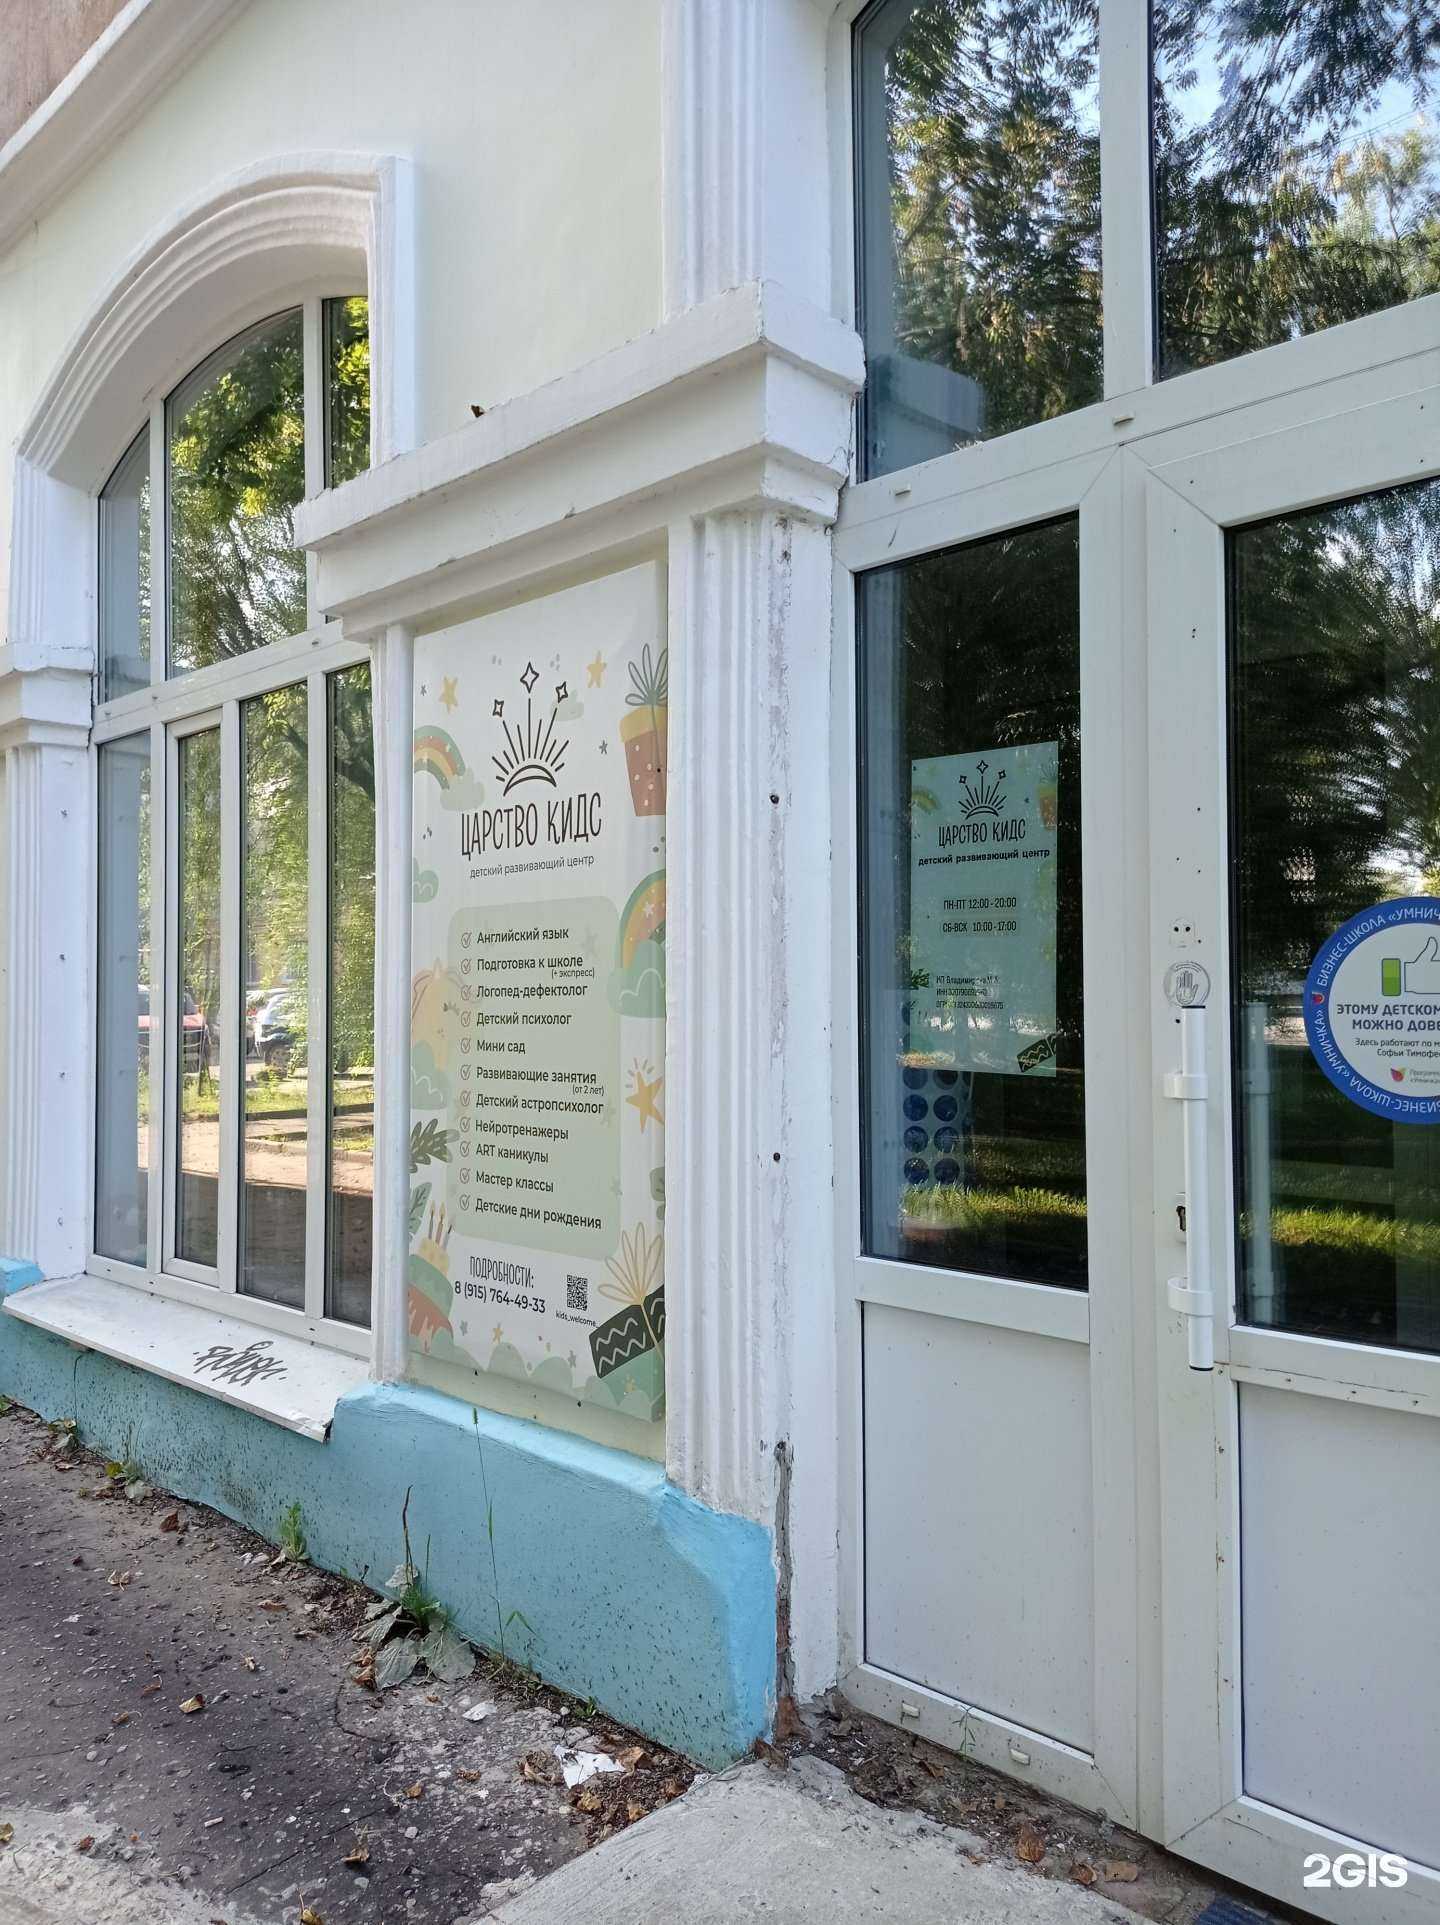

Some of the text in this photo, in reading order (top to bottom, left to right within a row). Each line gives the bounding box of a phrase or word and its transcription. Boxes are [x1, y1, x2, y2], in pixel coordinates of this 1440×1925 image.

[461, 792, 602, 861] ЦАРСТВО КИДС
[938, 818, 1026, 848] ЦАРСТВО КИДС
[918, 849, 1050, 866] детский развивающий центр
[470, 854, 595, 879] детский развивающий центр
[943, 899, 966, 910] ПН-ПТ
[968, 898, 989, 909] 12:00
[995, 897, 1017, 908] 20:00
[943, 922, 967, 933] СБ-ВСК
[972, 921, 993, 932] 10:00
[998, 920, 1017, 931] 17:00
[476, 928, 569, 944] Английский язык
[1316, 914, 1387, 987] БИЗНЕС-ШКОЛА
[476, 956, 583, 972] Подготовка к школе
[559, 968, 595, 979] экспресс)
[476, 984, 588, 999] Логопед-дефектолог
[1336, 1004, 1379, 1015] ЭТОМУ
[476, 1012, 572, 1027] Детский психолог
[1352, 1019, 1404, 1031] МОЖНО
[476, 1039, 526, 1054] Мини сад
[1355, 1037, 1379, 1047] Здесь
[1380, 1038, 1419, 1048] работают
[1377, 1048, 1440, 1059] Софьи Тимофе
[476, 1066, 597, 1085] Развивающие занятия
[572, 1085, 605, 1096] (от 2 лет)
[476, 1093, 604, 1114] Детский астропсихолог
[475, 1119, 569, 1141] Нейротренажеры
[476, 1143, 549, 1164] ART каникулы
[476, 1170, 554, 1192] Мастер классы
[475, 1198, 602, 1229] Детские дни рождения
[469, 1255, 534, 1289] ПОДРОБНОСТИ:
[454, 1280, 546, 1314] 8 (915) 764-49-33
